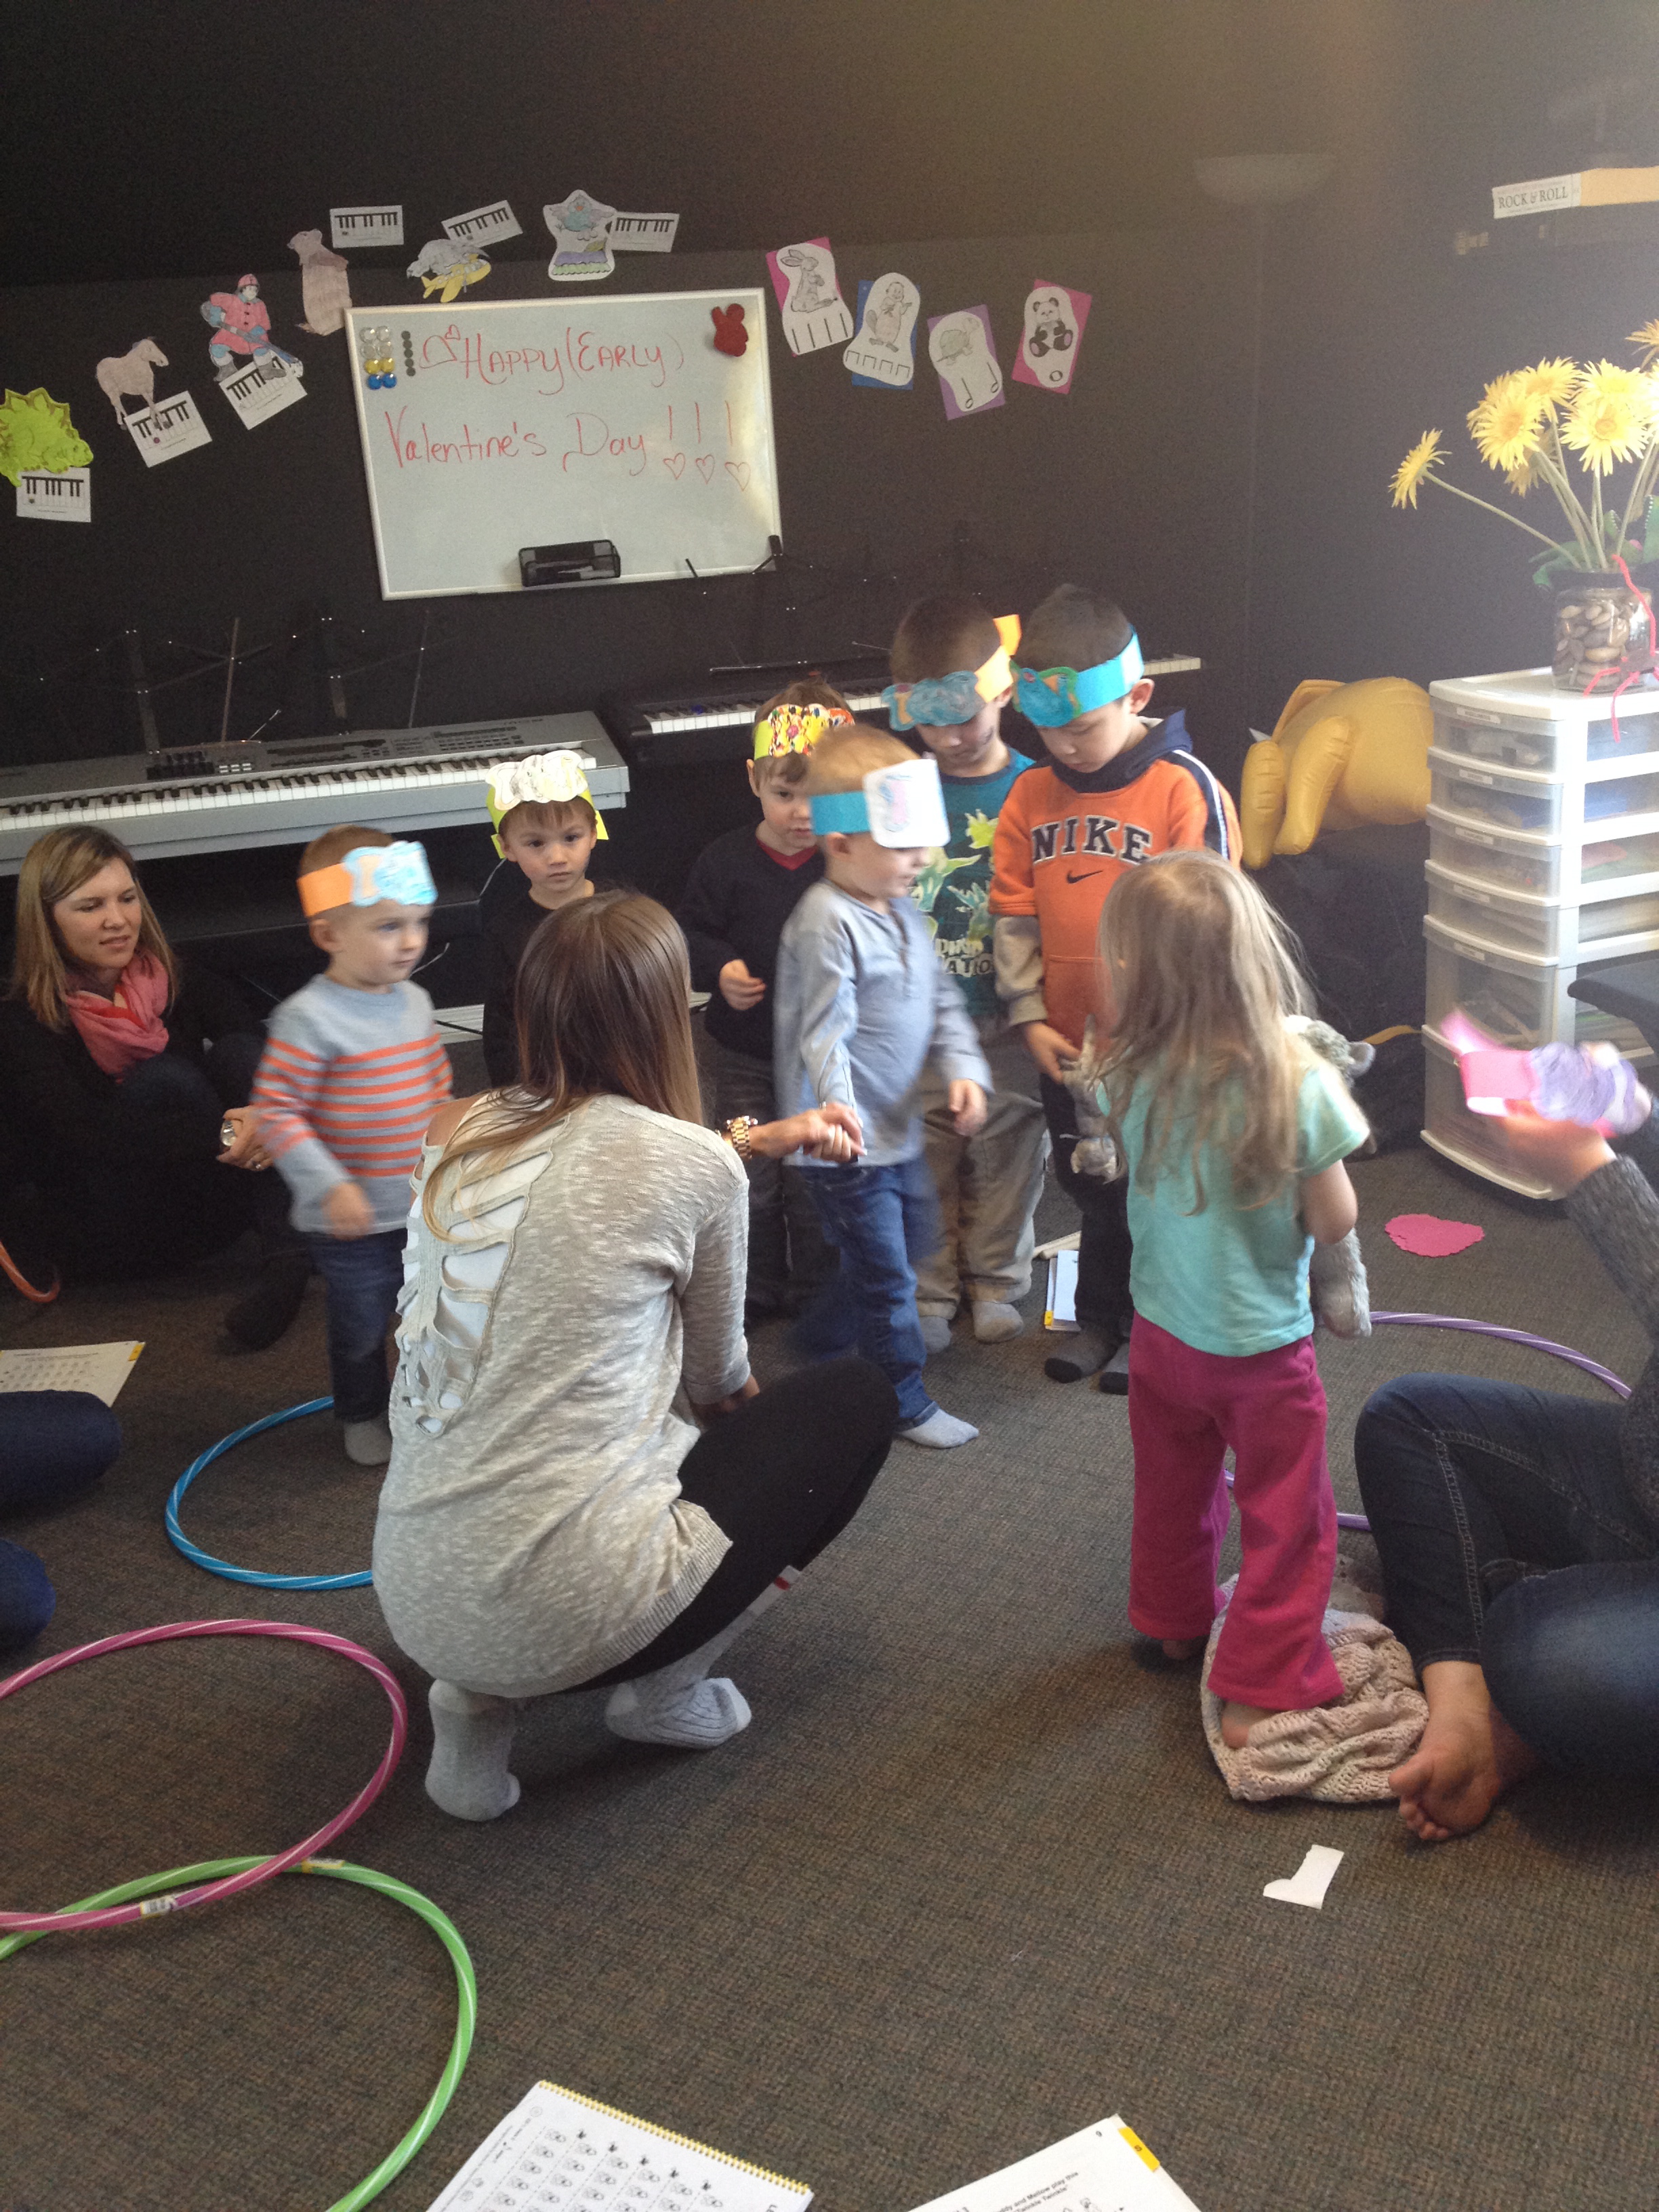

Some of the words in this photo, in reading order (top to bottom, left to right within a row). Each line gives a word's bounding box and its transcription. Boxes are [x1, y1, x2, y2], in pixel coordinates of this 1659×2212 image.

[1498, 192, 1528, 209] ROCK
[1539, 186, 1568, 203] ROLL
[384, 405, 547, 468] Valentine's
[562, 411, 647, 476] Day
[1031, 815, 1152, 866] NIKE
